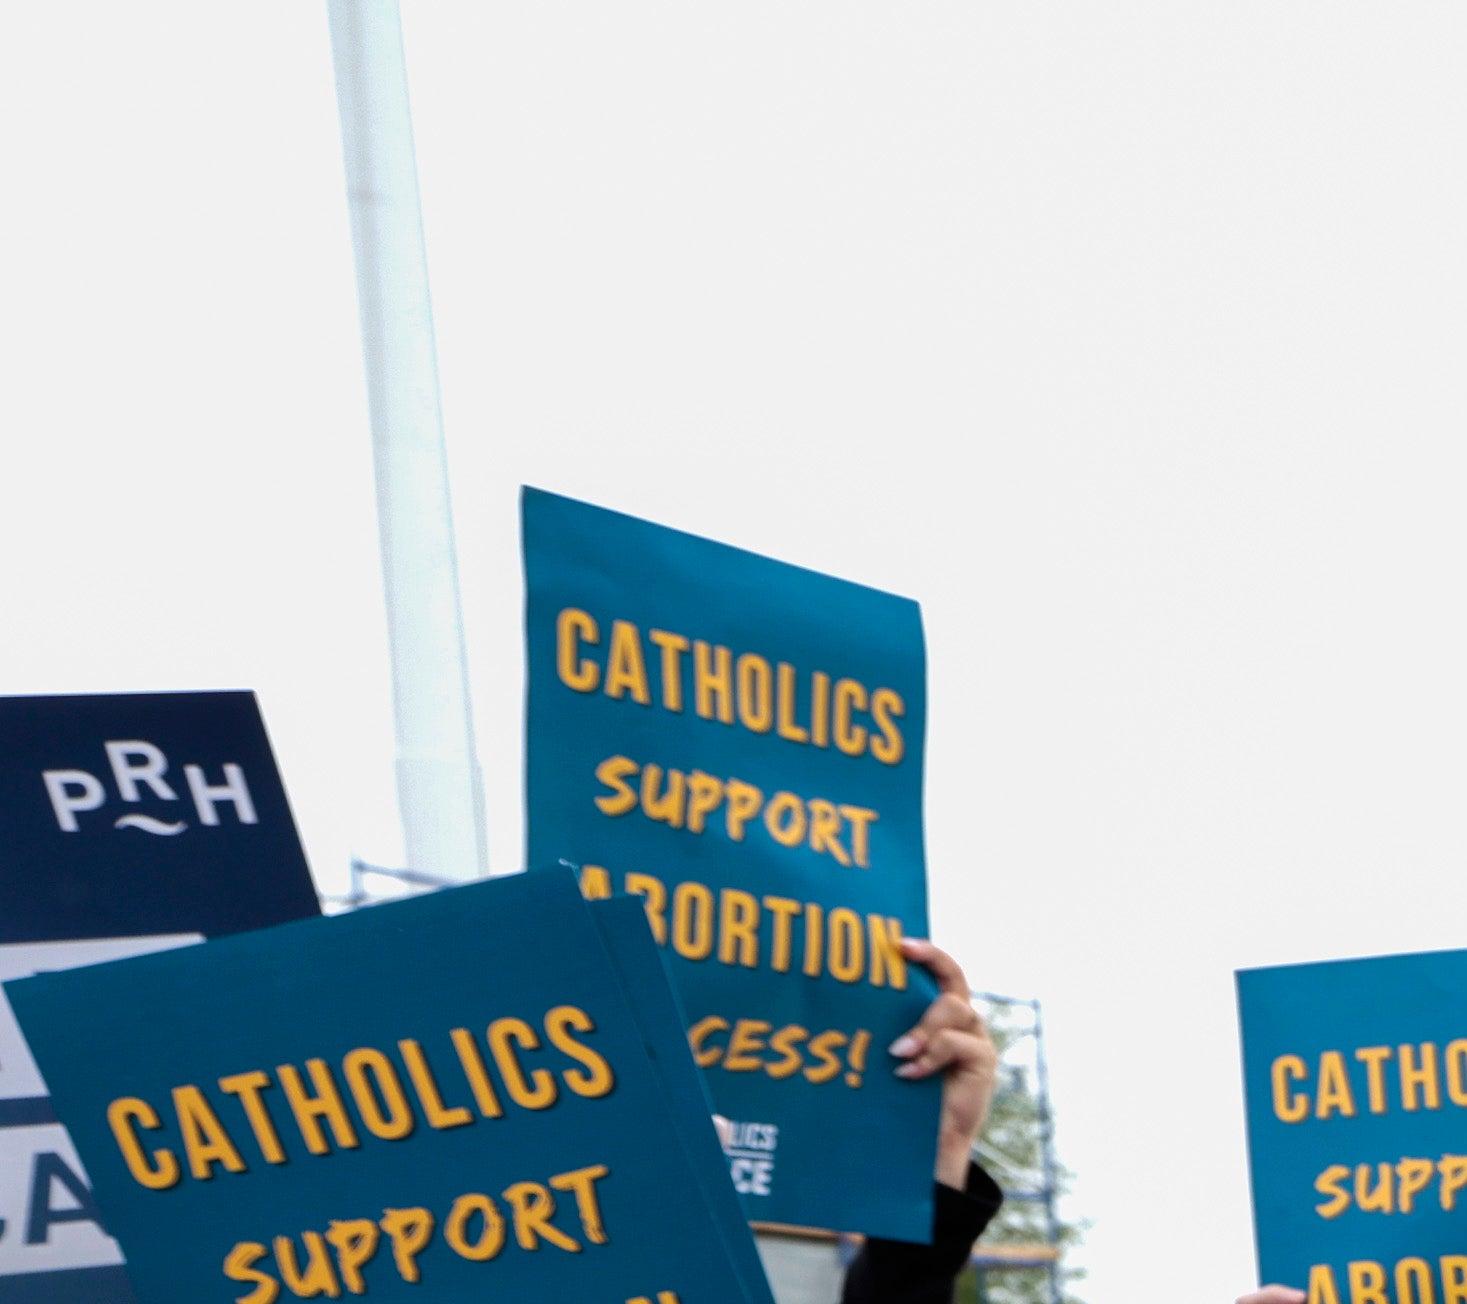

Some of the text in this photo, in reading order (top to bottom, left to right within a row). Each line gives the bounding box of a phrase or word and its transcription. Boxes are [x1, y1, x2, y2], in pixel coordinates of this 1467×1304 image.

[556, 608, 907, 767] CATHOLICS
[42, 740, 259, 834] PRH
[594, 755, 879, 869] SUPPORT
[106, 1005, 616, 1191] CATHOLICS
[687, 1015, 872, 1089] CESS!
